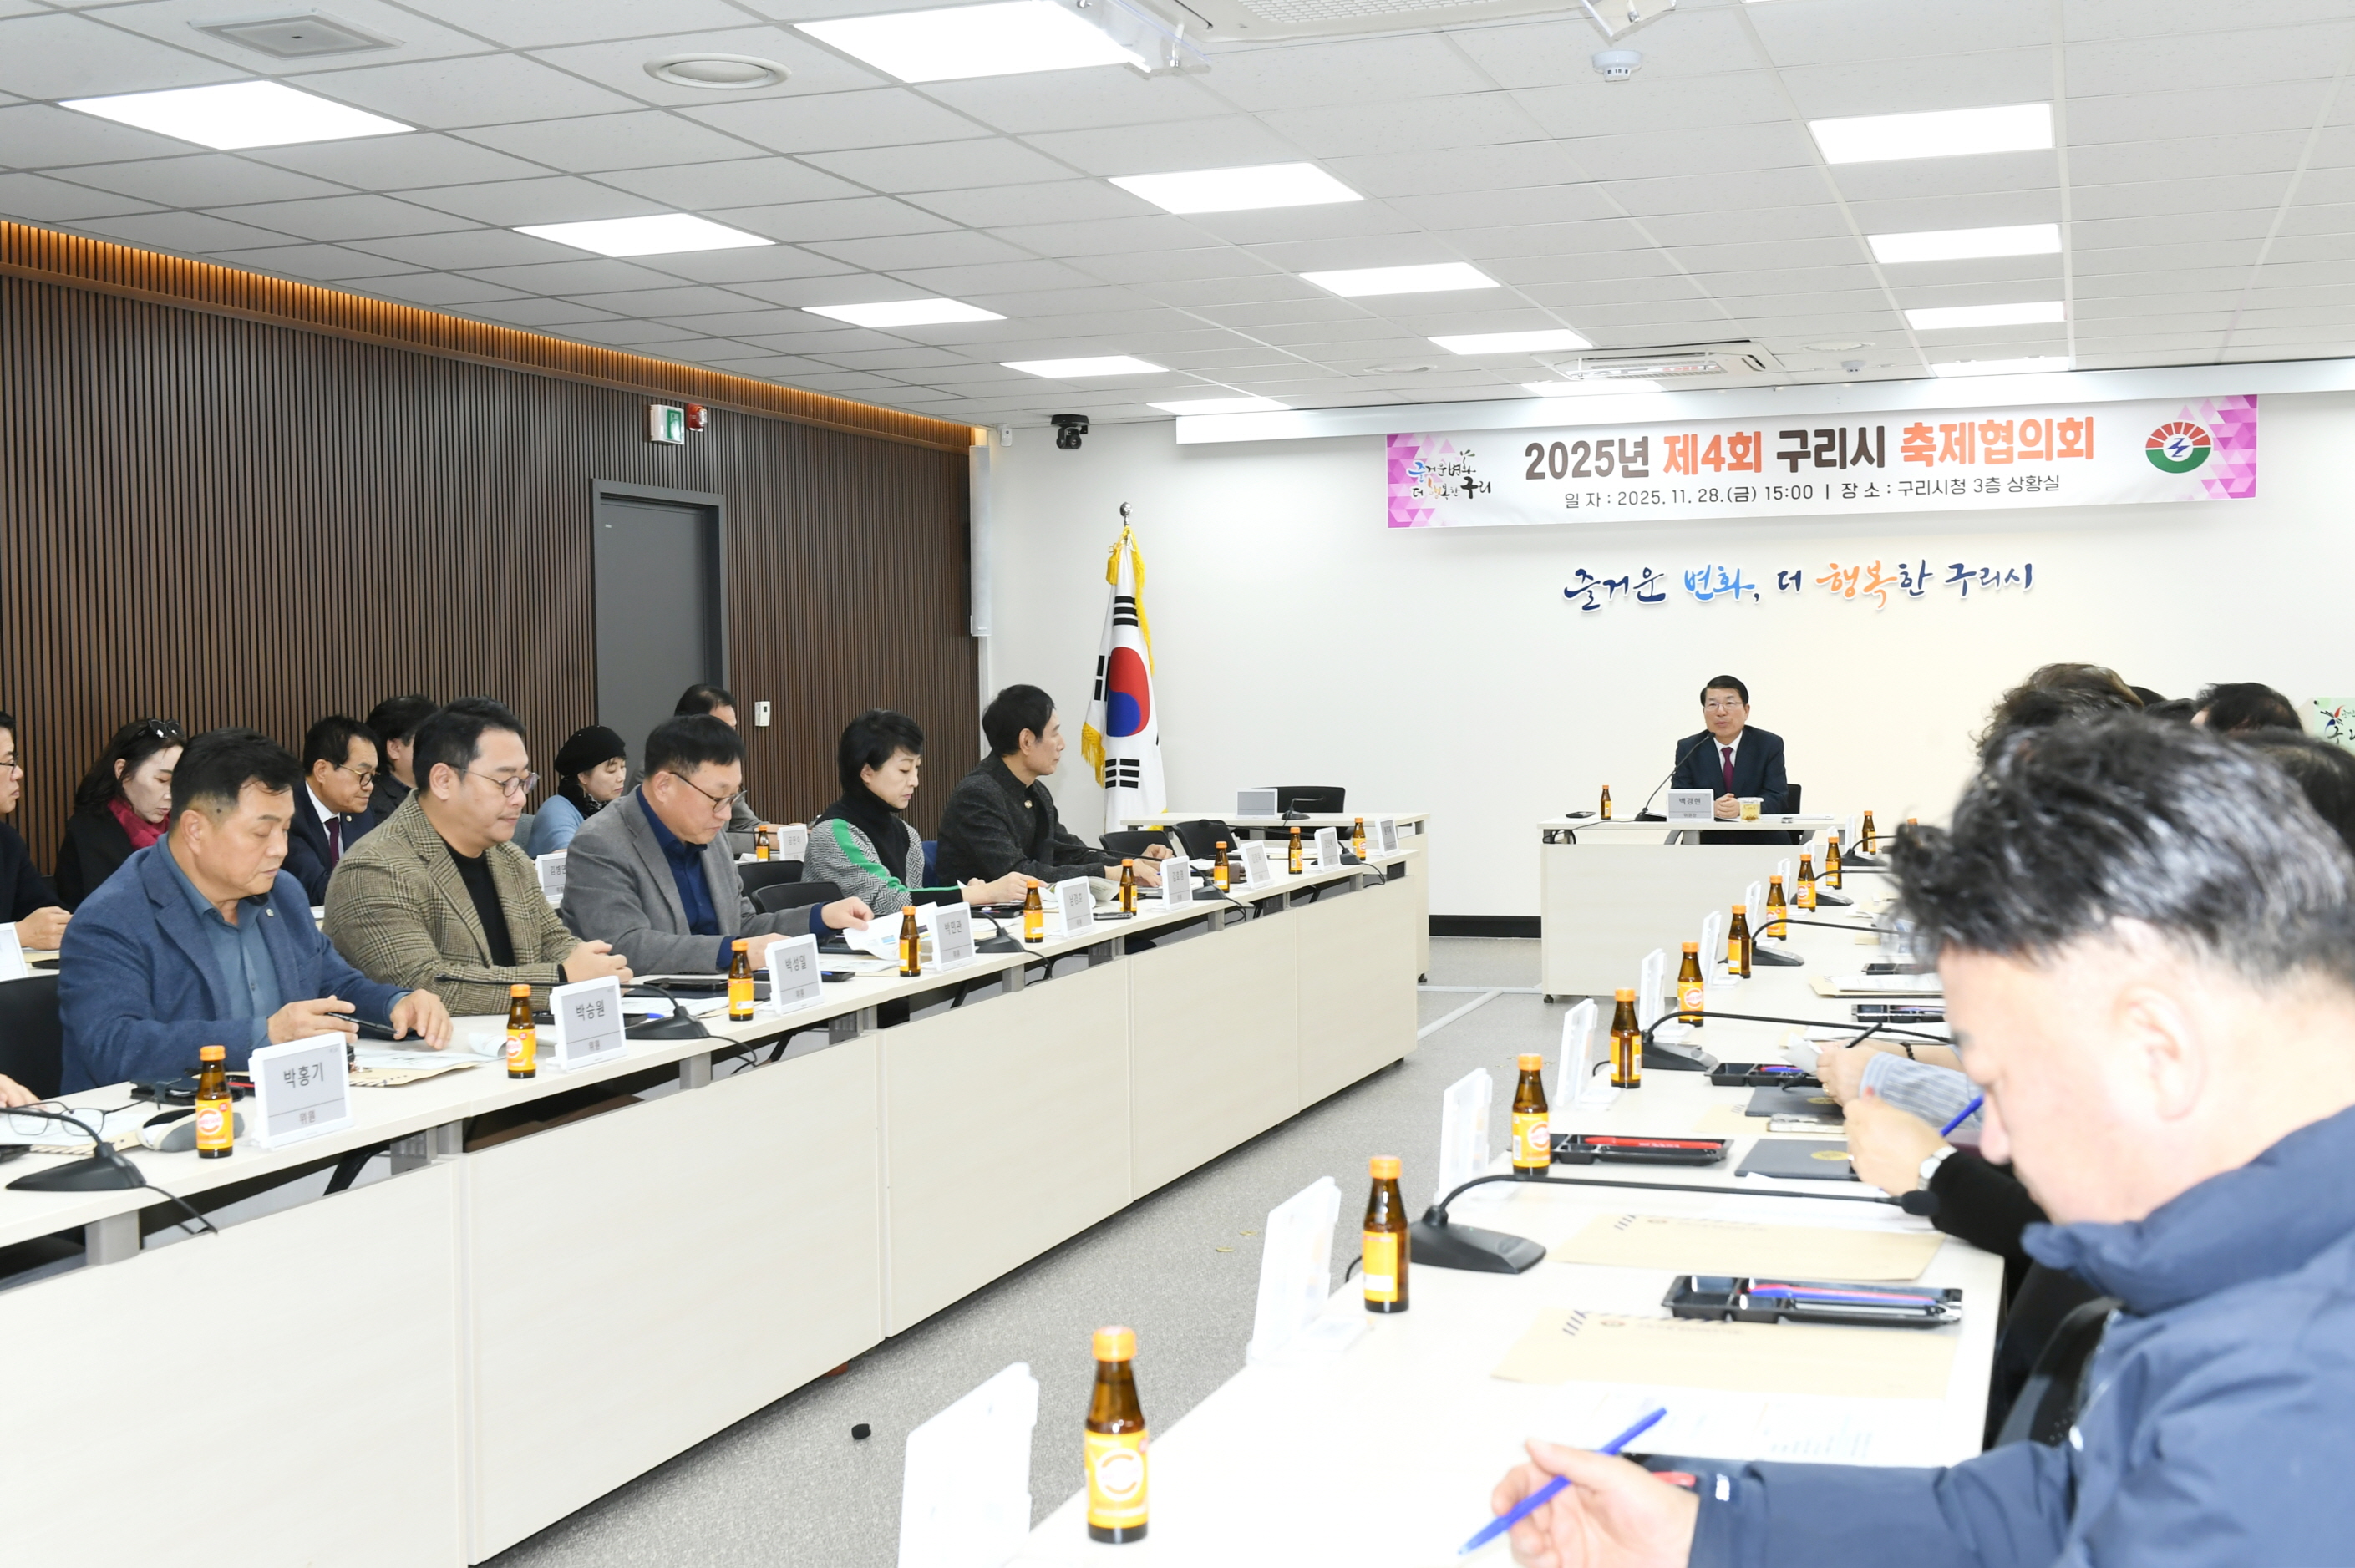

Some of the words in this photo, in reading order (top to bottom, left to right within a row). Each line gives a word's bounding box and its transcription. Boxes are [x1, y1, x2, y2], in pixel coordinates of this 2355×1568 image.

[1525, 436, 1650, 480] 2025년
[1663, 431, 1762, 475] 제4회
[1776, 424, 1886, 474] 구리시
[1901, 416, 2094, 468] 축제협의회
[1460, 476, 1492, 500] 구리
[1764, 484, 1814, 501] 15:00
[1897, 478, 1966, 497] 구리시청
[1973, 476, 2002, 494] 3층
[2007, 474, 2059, 493] 상황실
[1564, 567, 1666, 613] 즐거운
[1683, 564, 1760, 603] 변화,
[1777, 569, 1802, 592] 더
[1815, 559, 1934, 609] 행복한
[1945, 562, 2033, 597] 구리시
[1678, 797, 1701, 805] 백경현
[575, 999, 606, 1022] 박승원
[283, 1061, 324, 1088] 박홍기
[299, 1109, 316, 1125] 위원
